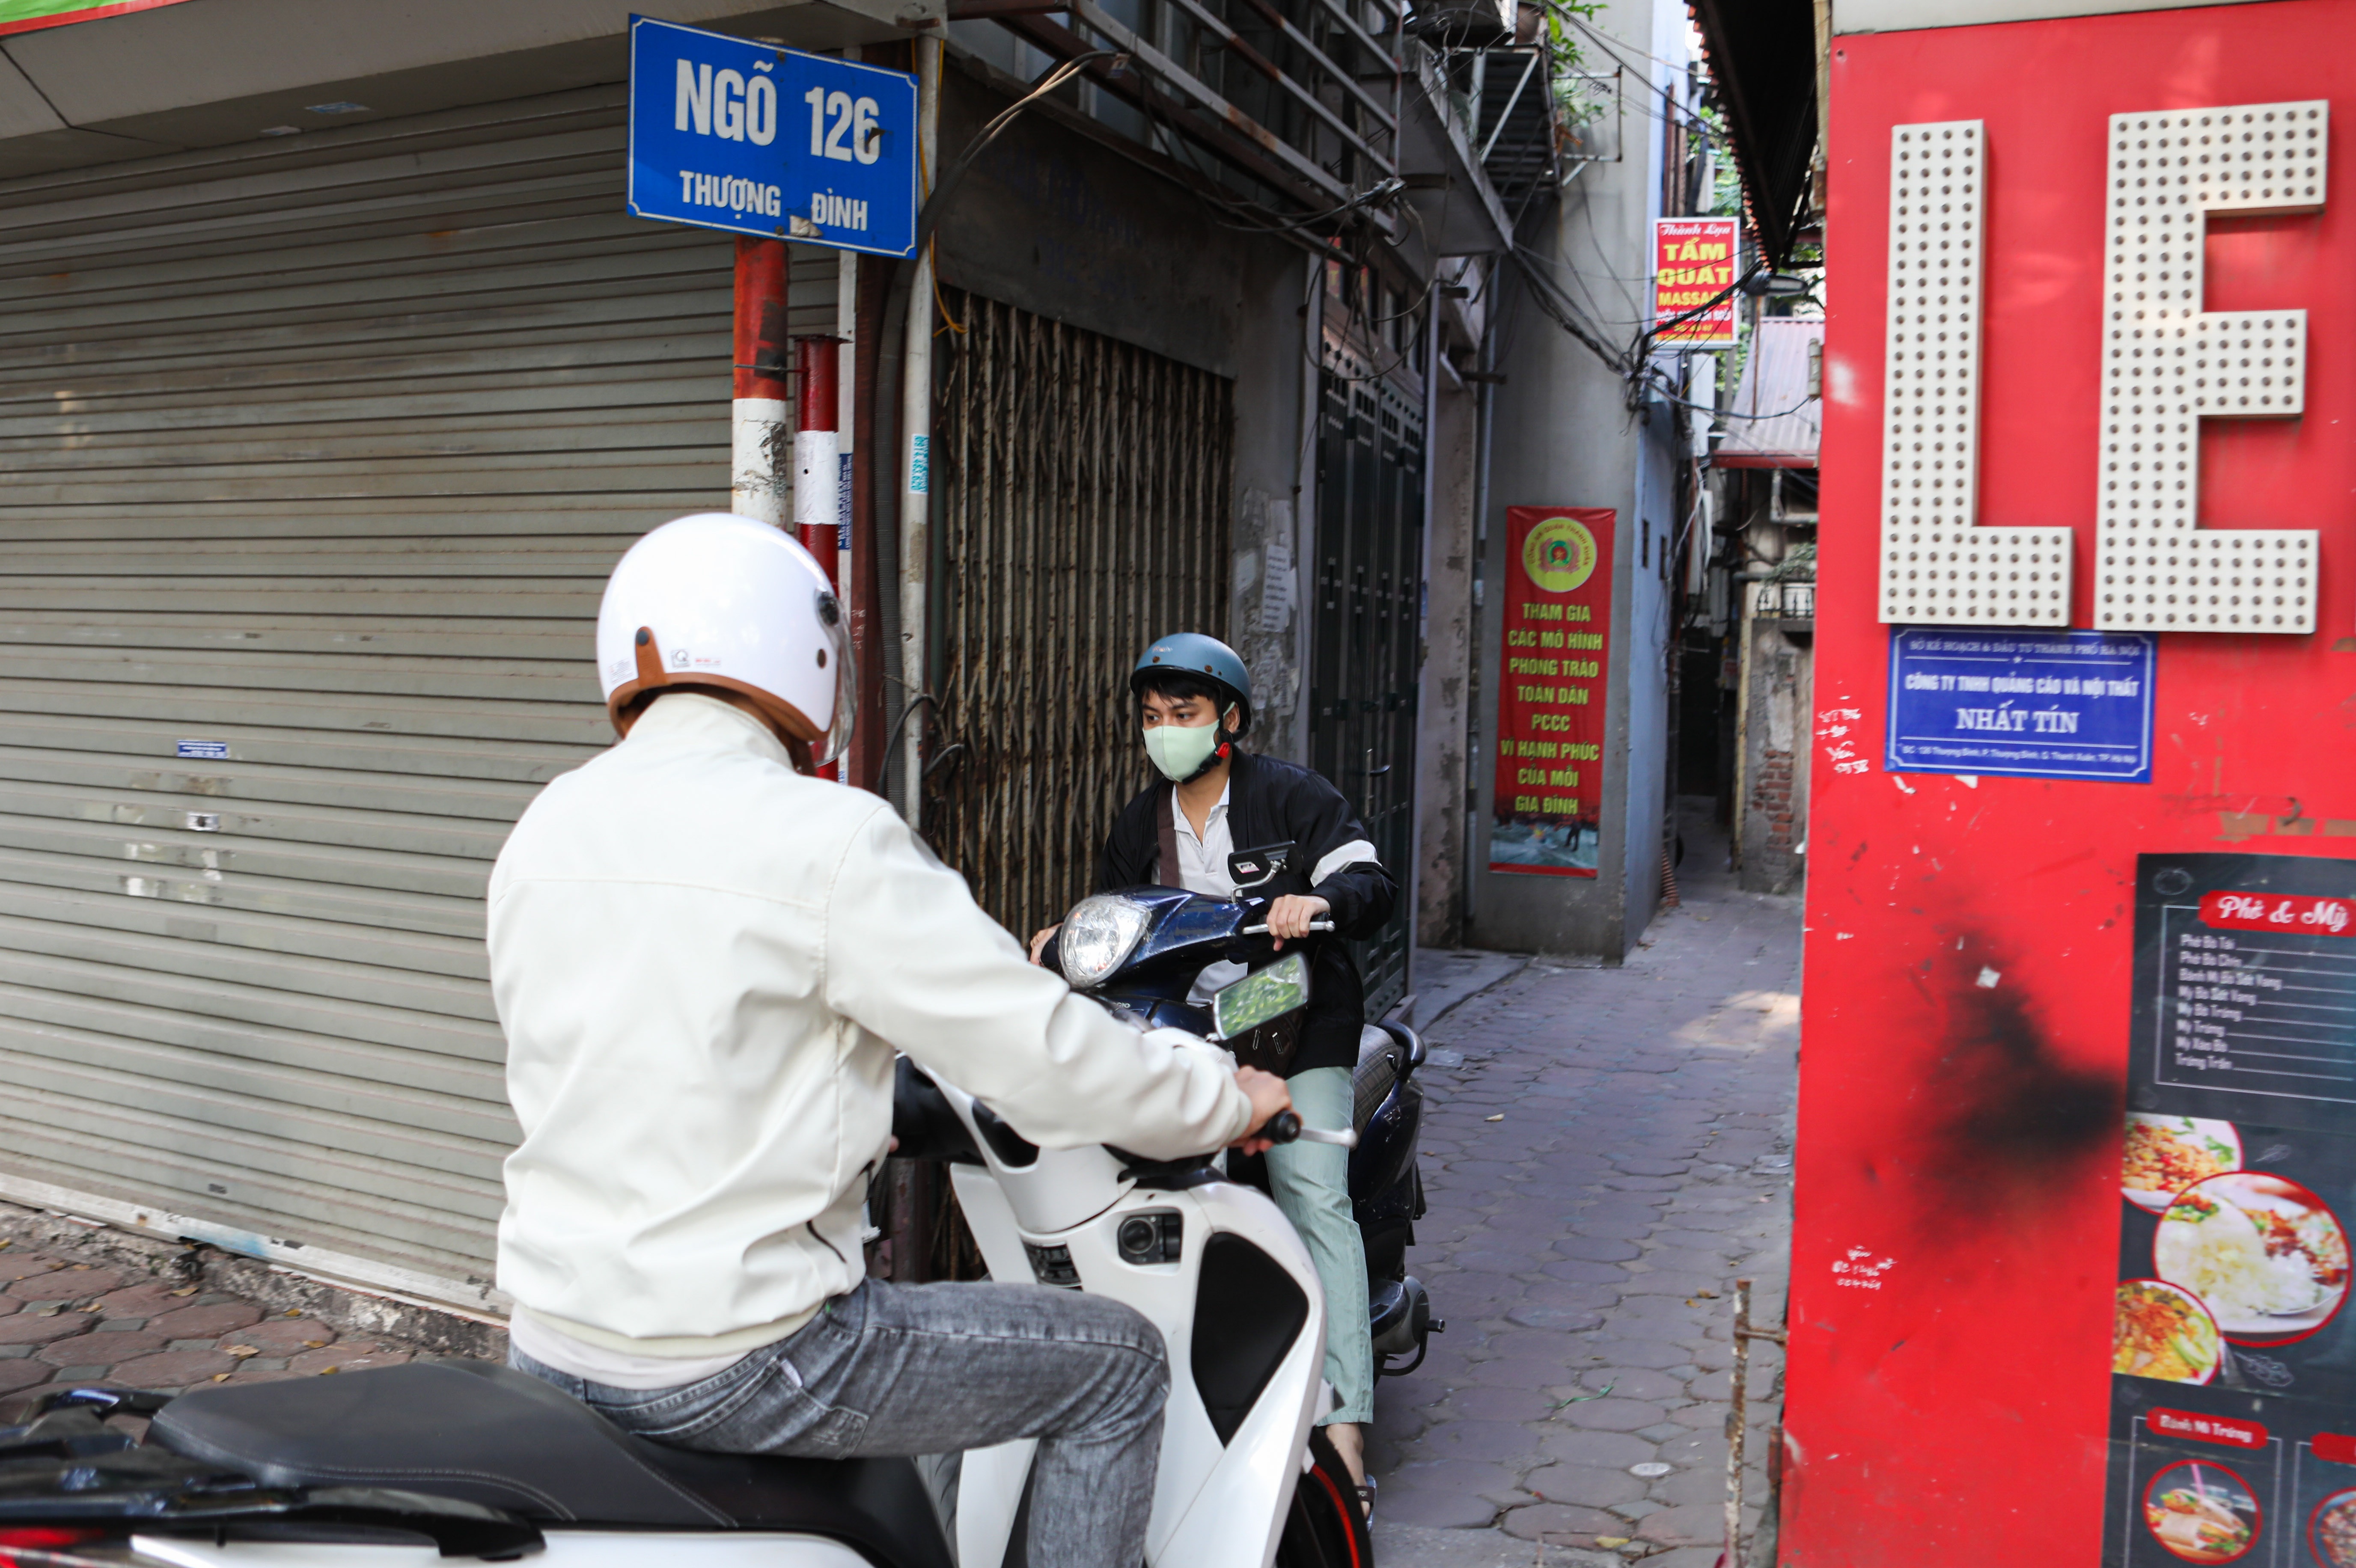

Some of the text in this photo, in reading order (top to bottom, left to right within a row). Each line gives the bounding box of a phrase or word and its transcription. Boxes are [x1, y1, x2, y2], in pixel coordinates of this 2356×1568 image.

[675, 58, 881, 165] NGÕ 126
[680, 170, 868, 231] THƯỢNG ĐÌNH
[1879, 99, 2329, 634] LE
[1522, 603, 1591, 622] THAM GIA
[1508, 627, 1537, 647] CÁC
[1540, 629, 1565, 648] MÔ
[1509, 657, 1559, 676] PHONG
[1905, 671, 1939, 691] CÔNG
[1940, 675, 1956, 691] TY
[1531, 713, 1571, 732] PCCC
[1956, 699, 2079, 734] NHẤT TÍN
[1518, 740, 1557, 761] HẠNH
[1561, 740, 1600, 761] PHÚC
[1515, 795, 1539, 812] GIA
[2269, 900, 2295, 923] &
